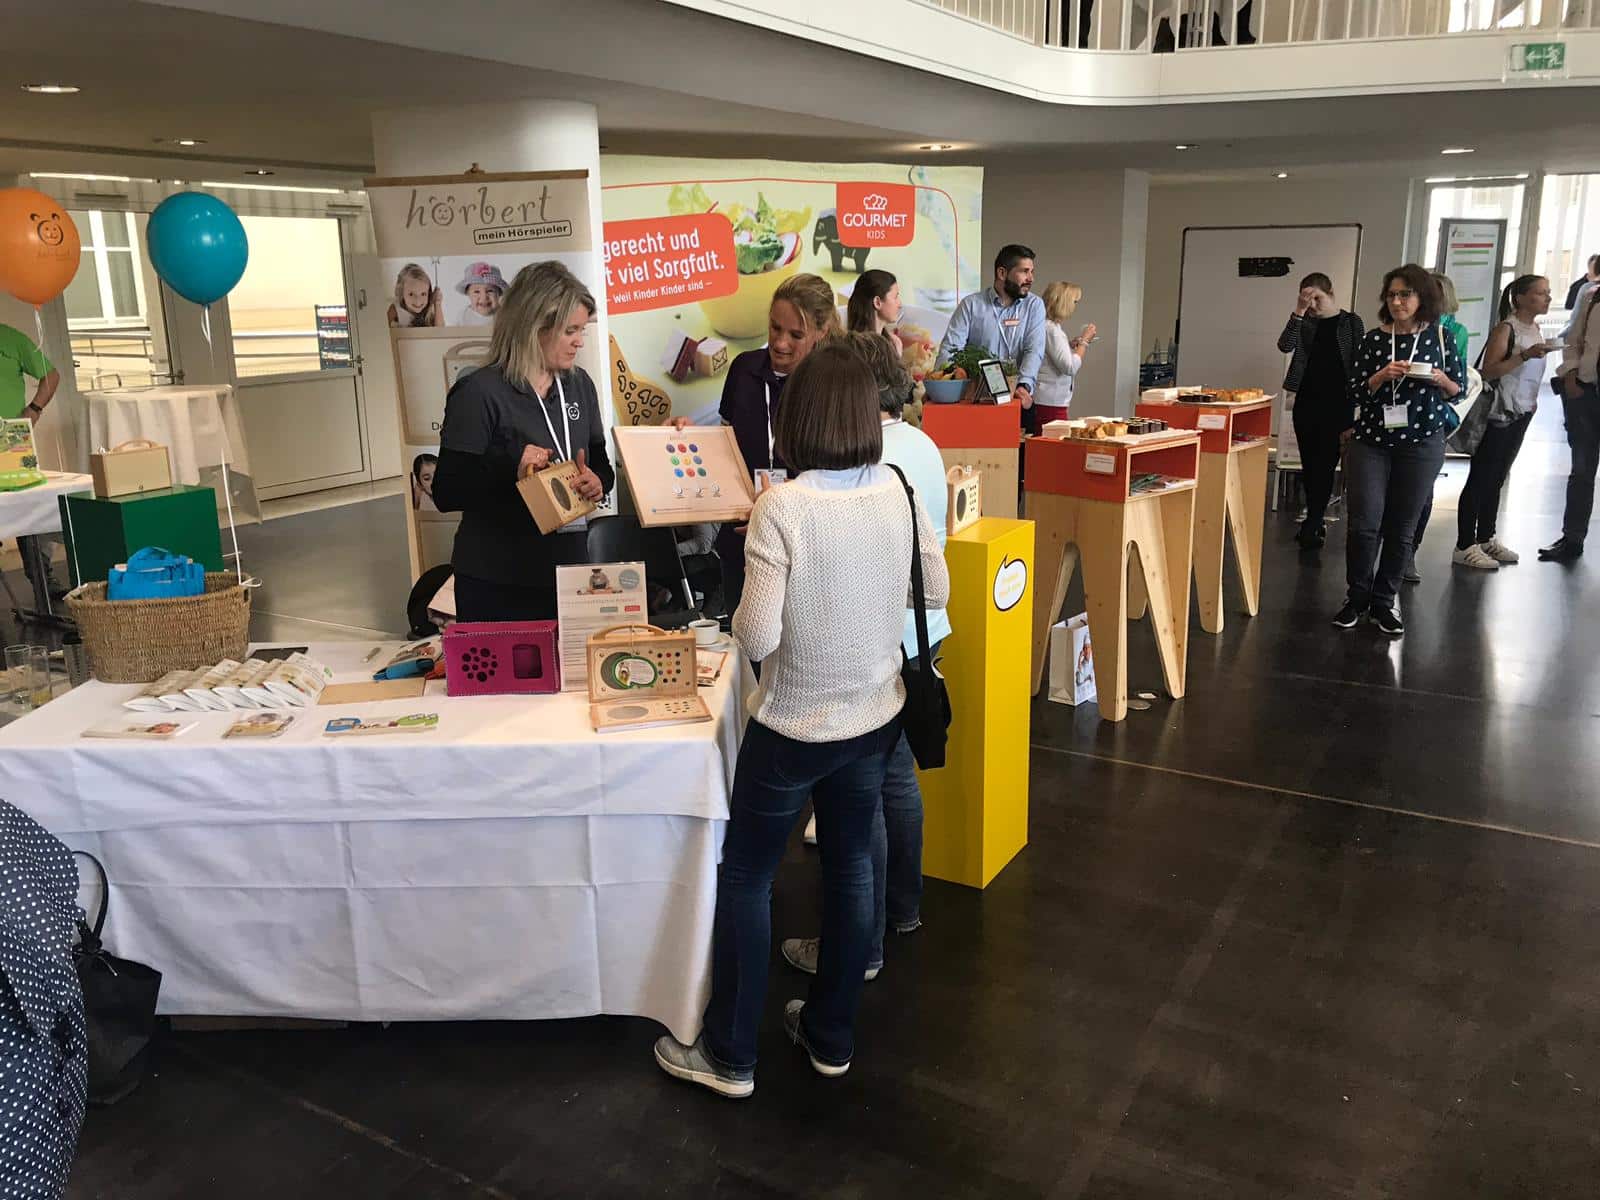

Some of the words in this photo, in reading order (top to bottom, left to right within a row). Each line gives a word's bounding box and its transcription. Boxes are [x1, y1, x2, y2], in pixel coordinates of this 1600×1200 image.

[406, 185, 551, 228] hörbert
[477, 230, 506, 241] mein
[507, 223, 569, 240] Hörspieler
[843, 213, 907, 227] GOURMET
[602, 231, 665, 262] gerecht
[670, 228, 699, 250] und
[866, 230, 886, 240] KIDS
[618, 260, 650, 285] viel
[654, 250, 725, 280] Sorgfalt.
[613, 292, 632, 304] Weil
[633, 288, 659, 301] Kinder
[661, 284, 687, 297] Kinder
[687, 280, 704, 291] sind
